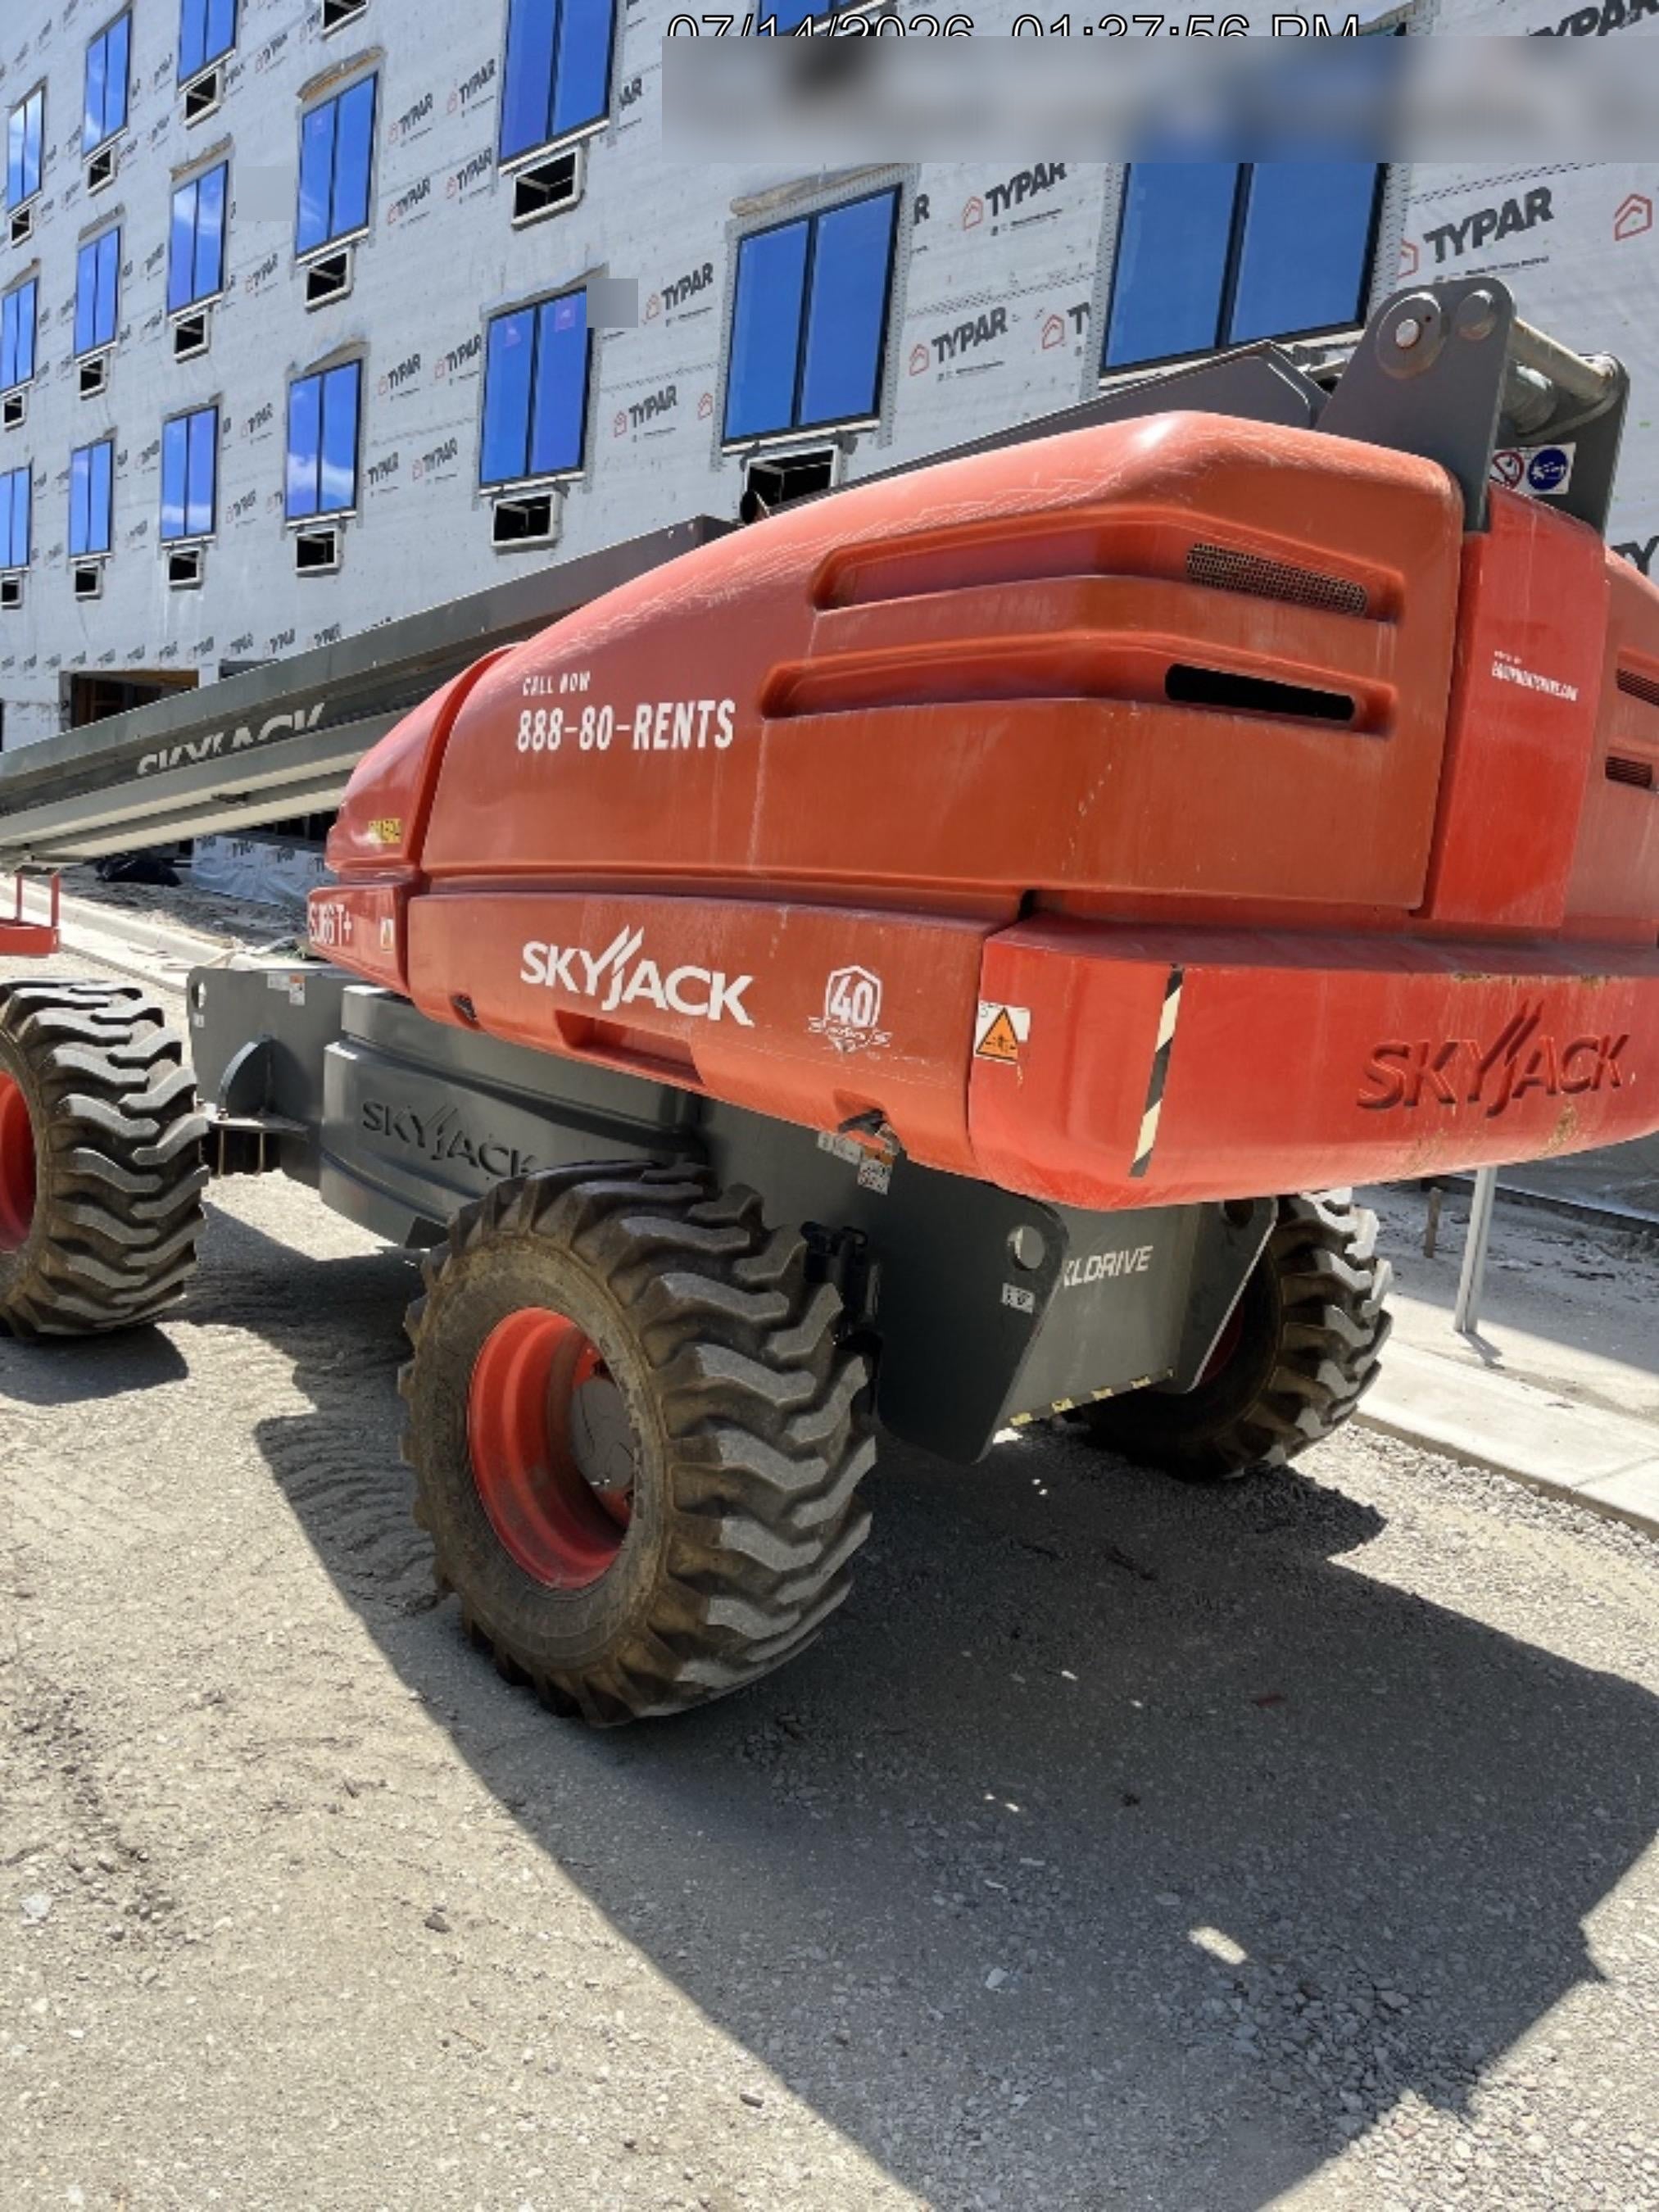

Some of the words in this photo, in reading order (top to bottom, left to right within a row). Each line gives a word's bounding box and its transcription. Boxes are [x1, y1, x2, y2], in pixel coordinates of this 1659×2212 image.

[1423, 187, 1554, 263] TYPAR
[661, 262, 714, 310] TYPAR
[931, 306, 1009, 364] TYPAR
[628, 385, 678, 428] TYPAR
[559, 671, 591, 694] NOW
[516, 698, 737, 753] 888-80-RENTS
[519, 924, 755, 1028] SKYJACK
[830, 976, 873, 1027] 40
[1356, 999, 1630, 1118] SKYJACK
[362, 1100, 538, 1178] SKYJACK
